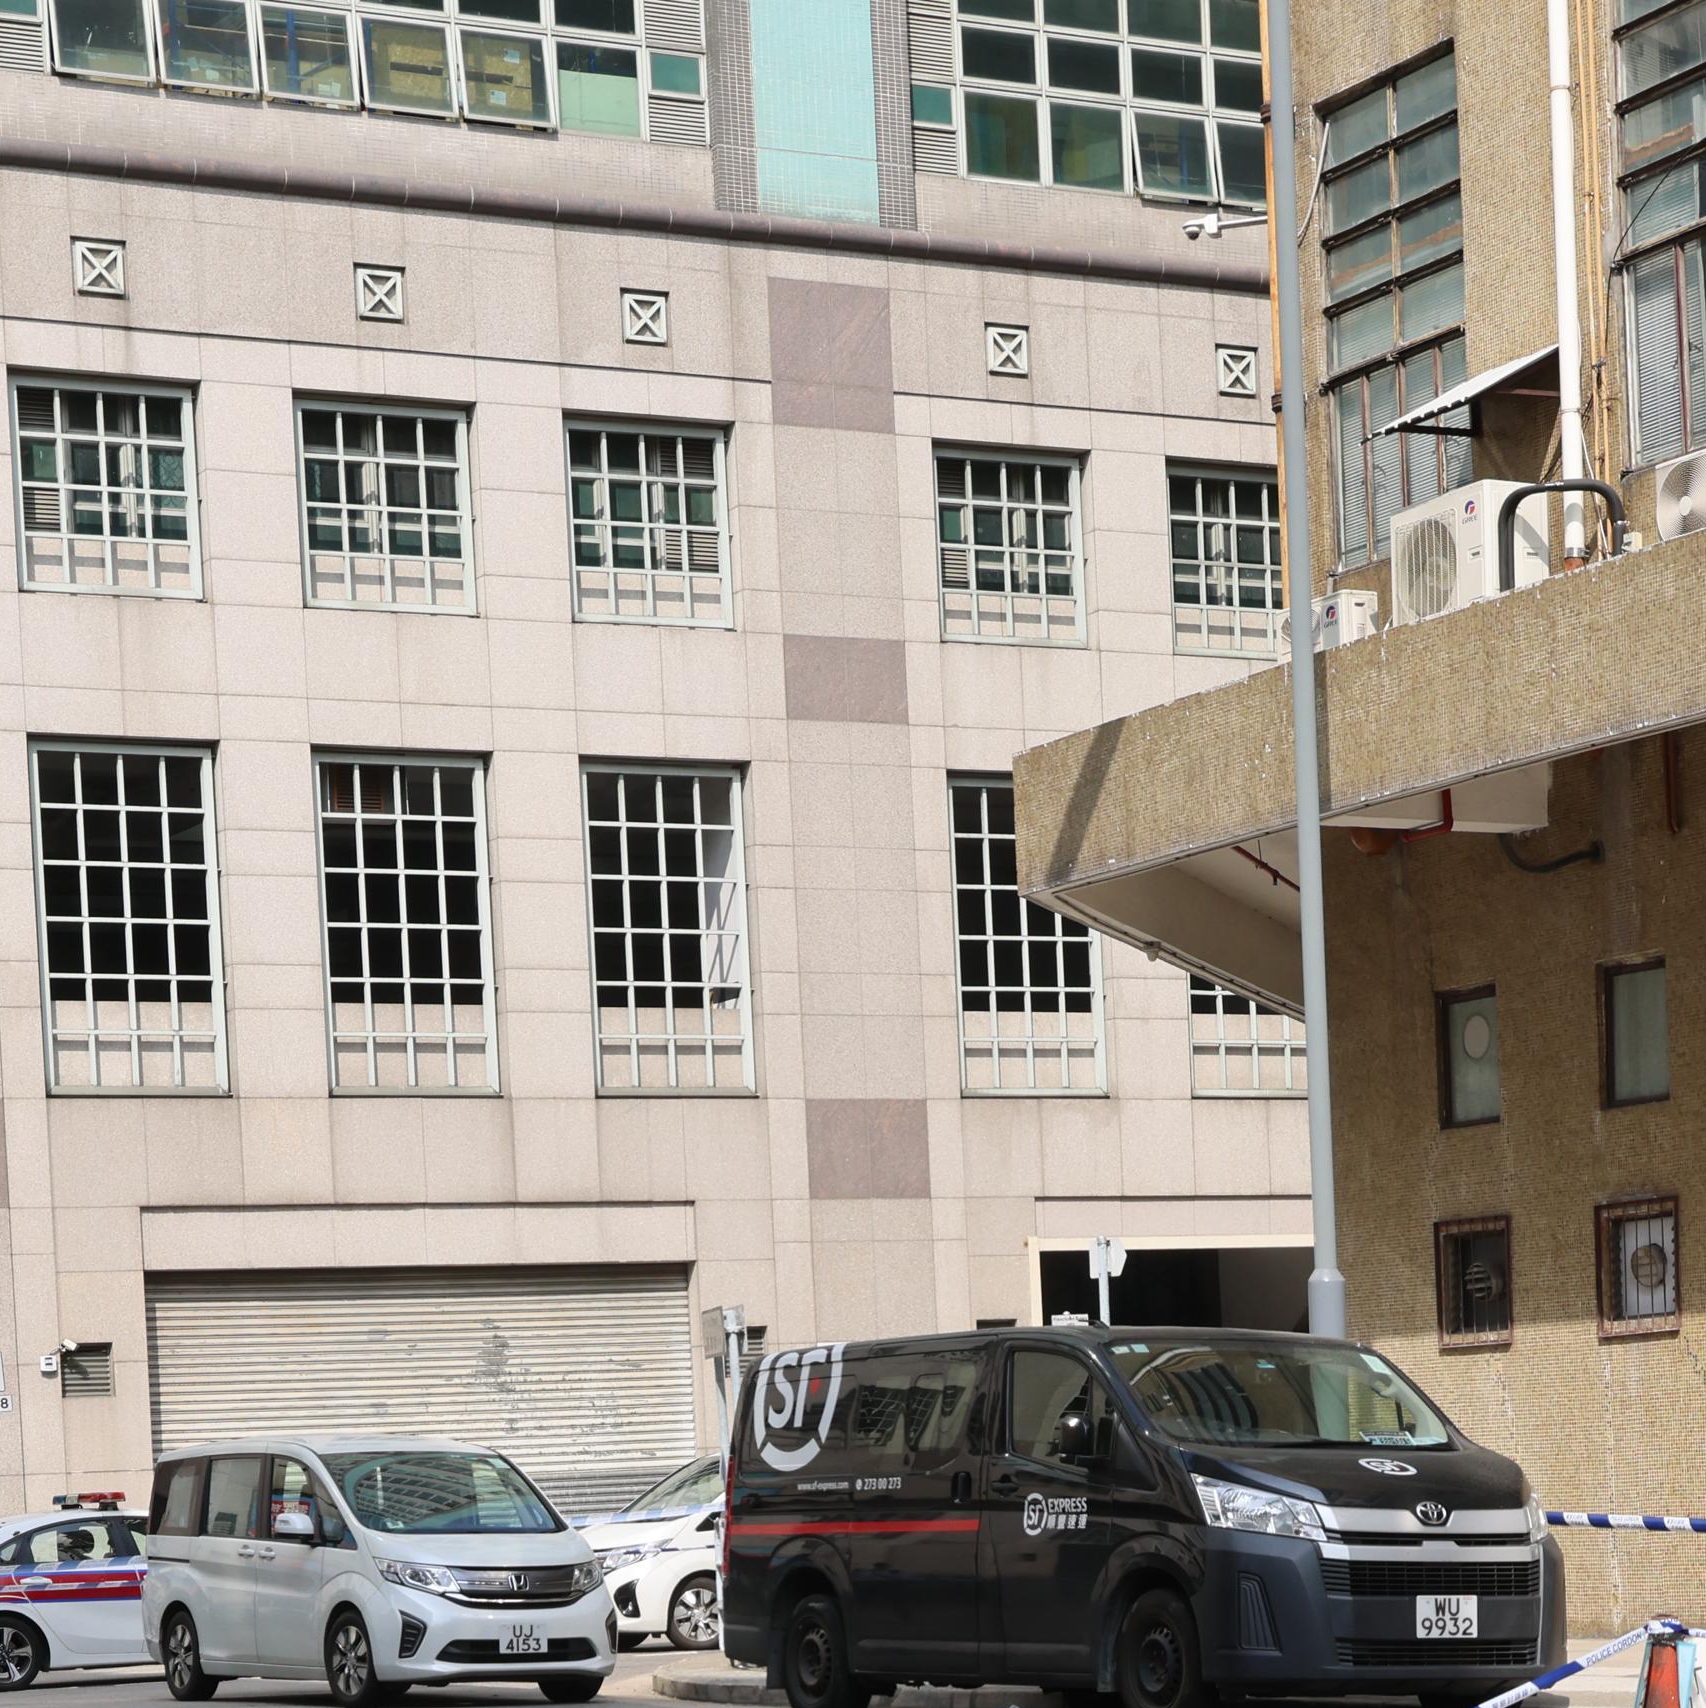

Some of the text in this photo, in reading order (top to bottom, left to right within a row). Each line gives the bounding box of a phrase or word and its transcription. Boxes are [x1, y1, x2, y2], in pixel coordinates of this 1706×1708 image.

[0, 1397, 9, 1409] 8
[863, 1478, 877, 1490] 273
[877, 1478, 888, 1489] 00
[888, 1477, 902, 1489] 273
[1048, 1497, 1088, 1513] EXPRESS
[1434, 1598, 1461, 1617] WU
[513, 1624, 533, 1639] UJ
[1421, 1617, 1474, 1637] 9932
[505, 1638, 541, 1652] 4153
[1586, 1633, 1645, 1666] POLICE CORDON
